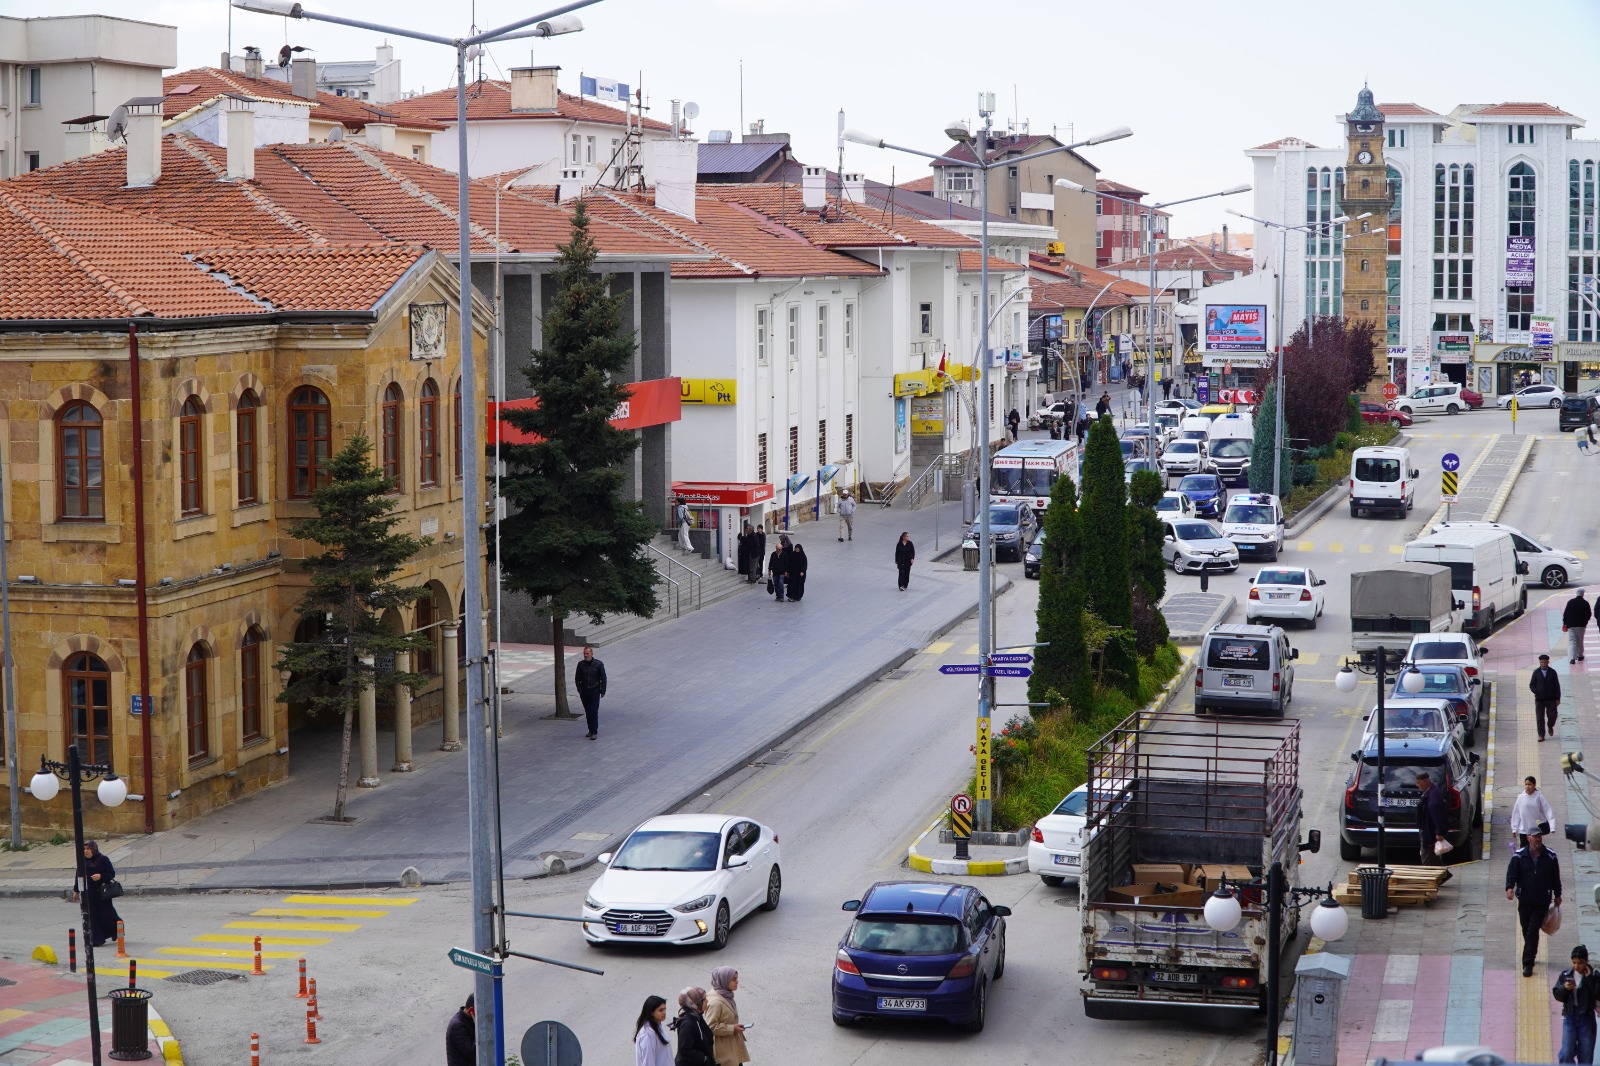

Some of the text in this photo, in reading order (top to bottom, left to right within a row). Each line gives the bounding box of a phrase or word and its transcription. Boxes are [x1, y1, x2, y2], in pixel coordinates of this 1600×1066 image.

[1232, 313, 1257, 321] MAYIS
[1382, 387, 1398, 395] DUR
[718, 392, 731, 402] Ptt
[678, 492, 696, 501] Ziraat
[1155, 972, 1164, 980] 32
[1183, 973, 1196, 982] 971
[883, 999, 925, 1008] 34 AK 9733
